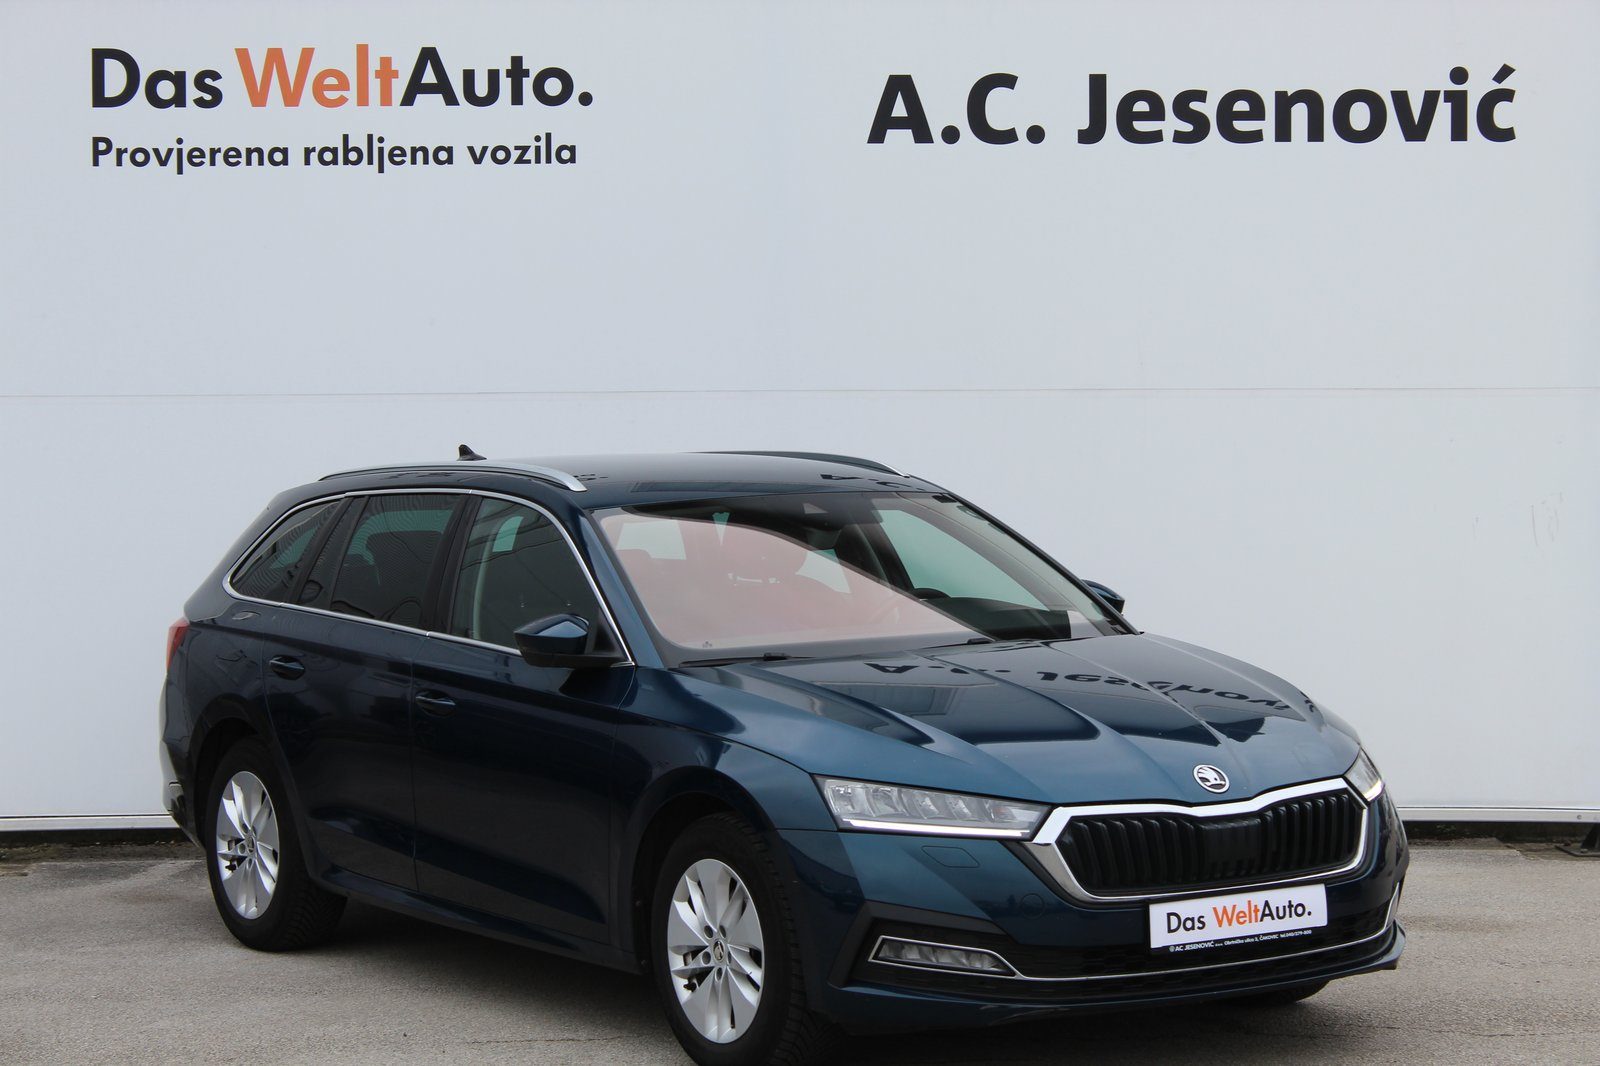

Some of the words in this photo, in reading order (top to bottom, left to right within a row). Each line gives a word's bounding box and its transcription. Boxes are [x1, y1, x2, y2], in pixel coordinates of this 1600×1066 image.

[91, 48, 223, 109] Das
[235, 44, 593, 108] WeltAuto.
[867, 73, 1045, 145] A.C.
[1078, 64, 1516, 144] Jesenović
[92, 137, 288, 175] Provjerena
[304, 134, 453, 173] rabljena
[467, 132, 576, 165] vozila
[1166, 911, 1206, 934] Das
[1212, 899, 1312, 928] WeltAuto.
[1184, 940, 1215, 951] JESENOVIĆ
